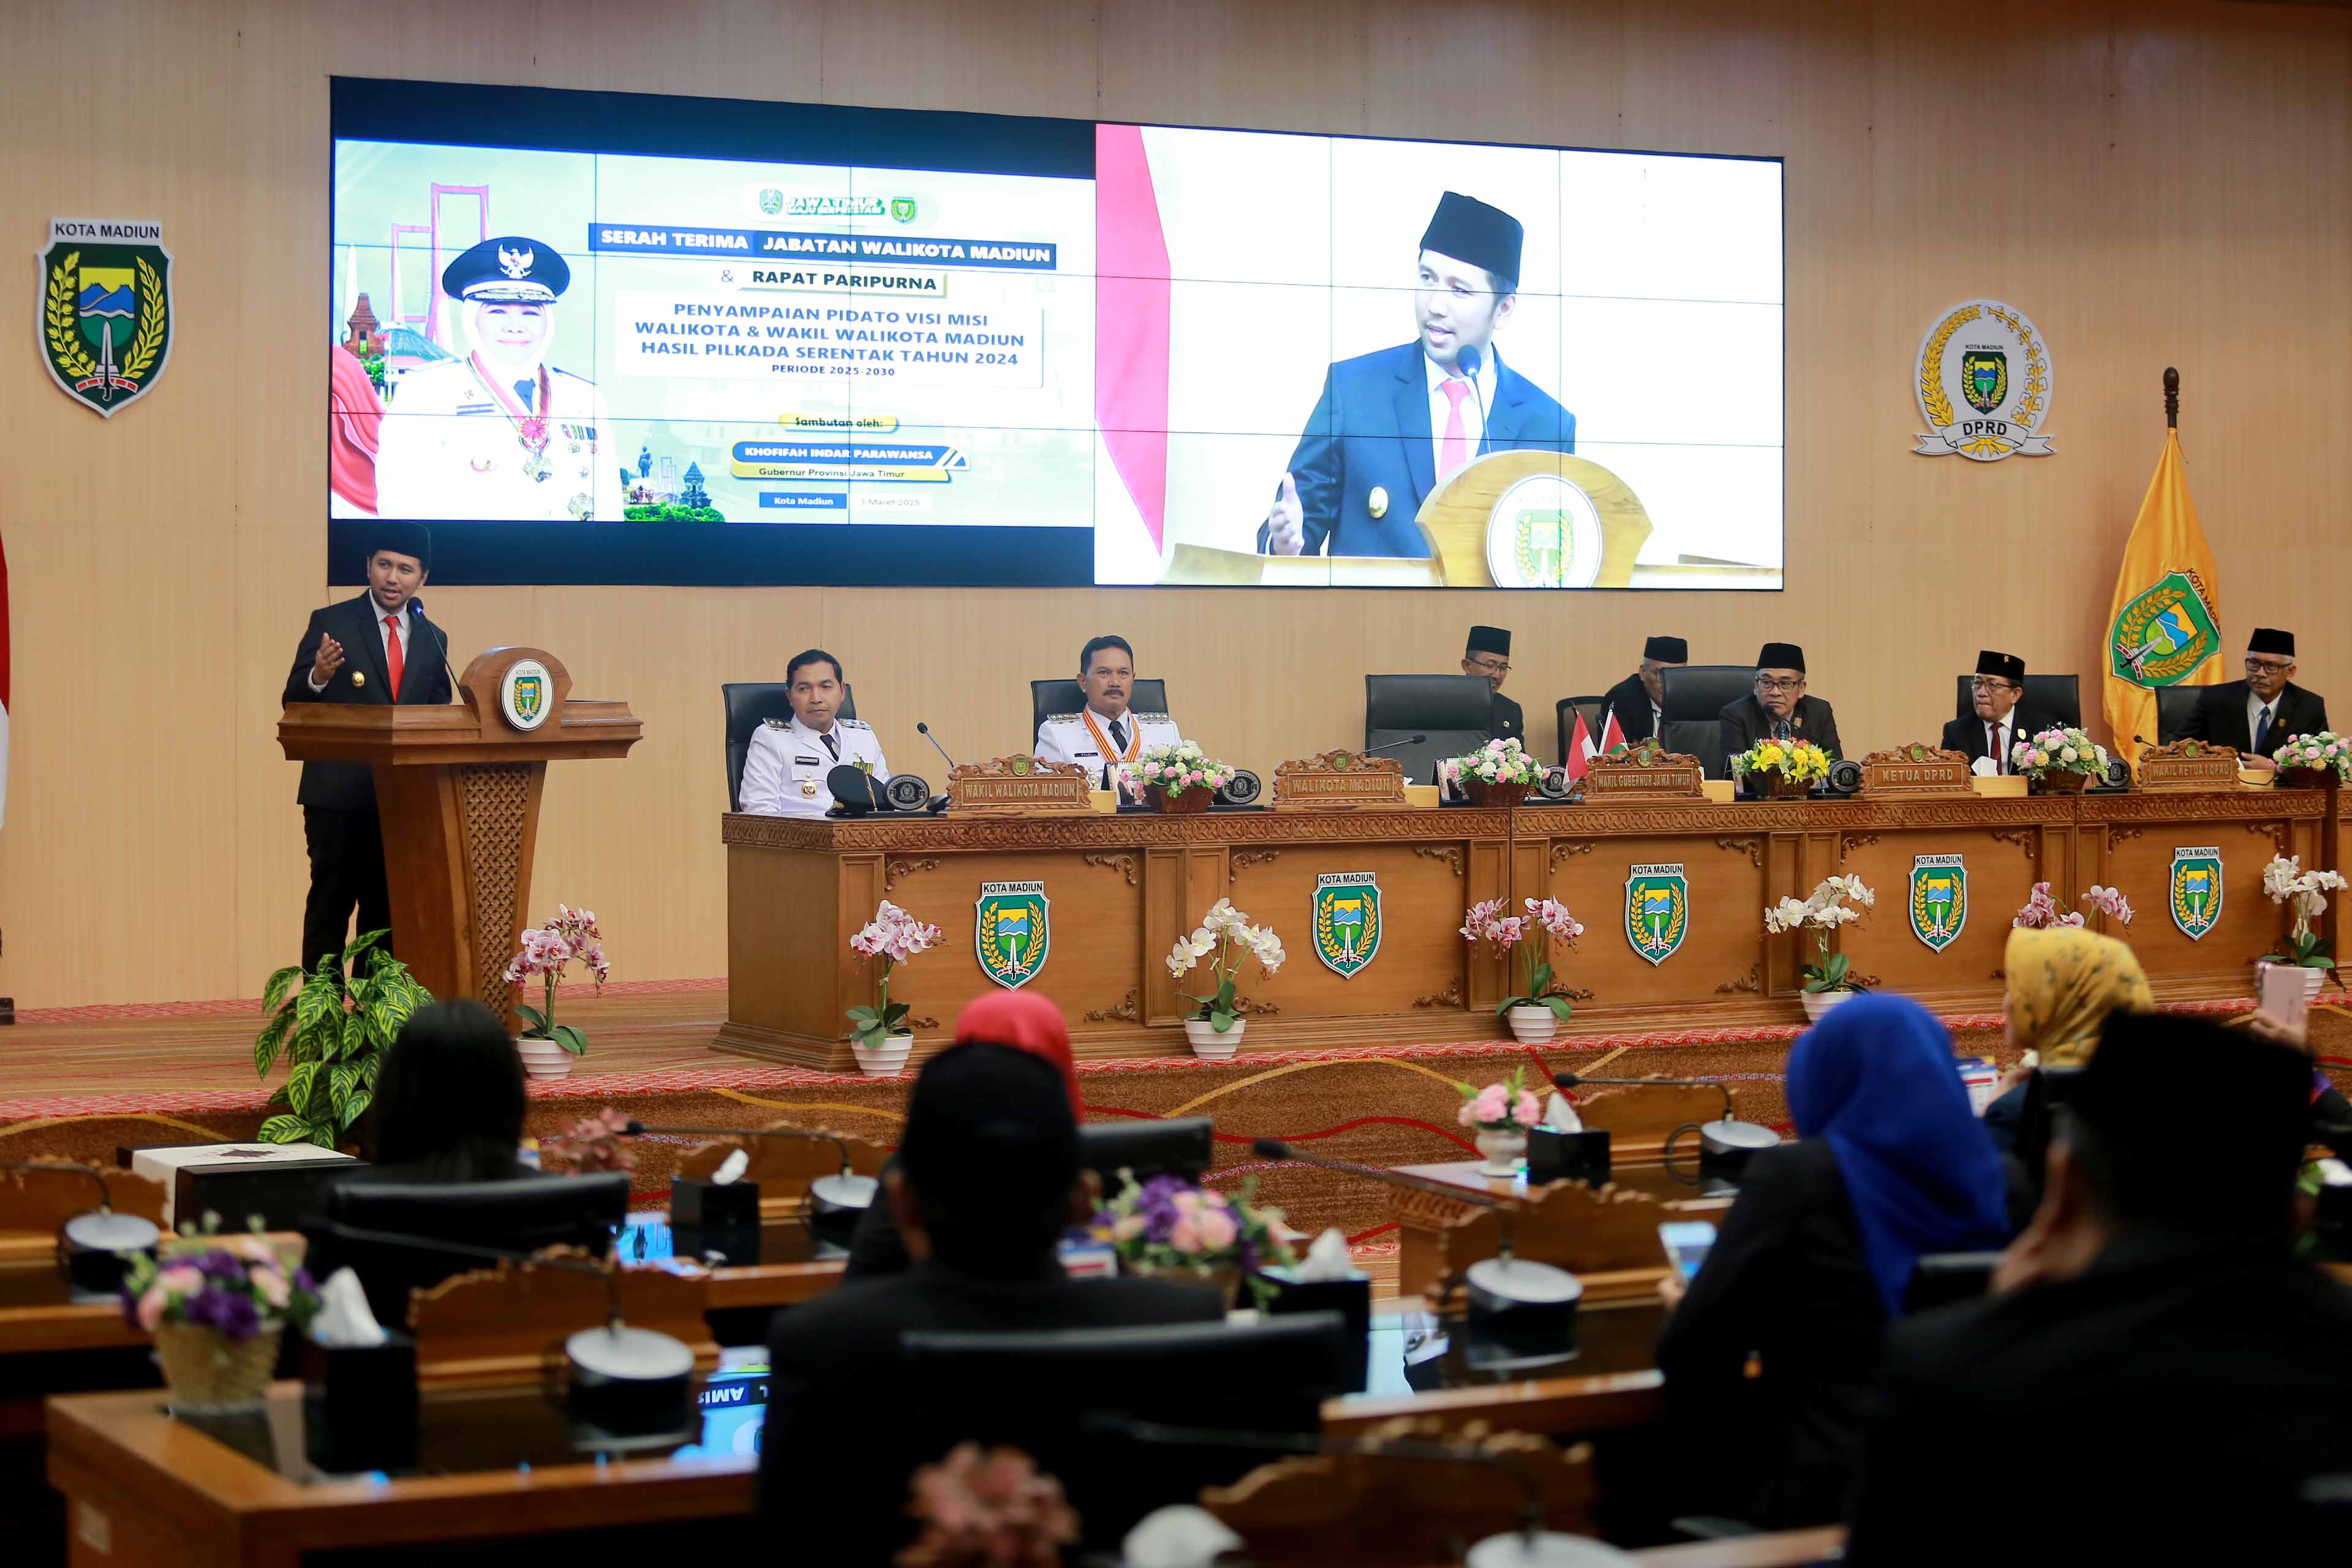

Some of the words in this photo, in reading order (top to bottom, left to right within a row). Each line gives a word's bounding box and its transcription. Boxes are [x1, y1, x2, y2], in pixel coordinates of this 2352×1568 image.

[55, 223, 96, 236] KOTA
[100, 225, 159, 238] MADIUN
[601, 230, 667, 246] SERAH
[671, 232, 749, 249] TERIMA
[763, 236, 857, 254] JABATAN
[861, 241, 966, 258] WALIKOTA
[970, 246, 1050, 262] MADIUN
[721, 270, 734, 282] &
[753, 271, 818, 285] RAPAT
[824, 273, 937, 290] PARIPURNA
[674, 303, 820, 320] PENYAMPAIAN
[827, 309, 900, 323] PIDATO
[906, 312, 941, 325] VISI
[948, 314, 987, 326] MISI
[635, 322, 740, 337] WALIKOTA
[747, 326, 760, 337] &
[766, 326, 829, 340] WAKIL
[835, 329, 938, 344] WALIKOTA
[945, 333, 1023, 347] MADIUN
[642, 342, 698, 355] HASIL
[706, 344, 789, 358] PILKADA
[796, 347, 894, 361] SERENTAK
[900, 350, 968, 363] TAHUN
[974, 353, 1018, 365] 2024
[772, 364, 826, 374] PERIODE
[830, 367, 895, 376] 2025-2030
[796, 417, 853, 428] Sambutan
[856, 419, 883, 428] oleh:
[1963, 421, 2007, 435] DPRD
[745, 447, 807, 458] KHOFIFAH
[810, 448, 850, 458] INDAR
[851, 450, 933, 459] PARAWANSA
[774, 497, 796, 505] Kota
[797, 497, 834, 506] Madiun
[2186, 568, 2206, 595] KOTA
[1882, 769, 1920, 782] KETUA
[1924, 769, 1953, 781] DPRD
[2152, 764, 2176, 776] WAKIL
[2179, 764, 2203, 775] KETUA
[2210, 764, 2230, 775] DPRD
[1292, 779, 1346, 793] WALIKOTA
[1349, 778, 1389, 792] MADIUN
[1597, 775, 1618, 788] WAKIL
[1619, 775, 1652, 787] GUBERNUR
[1653, 774, 1670, 786] JAWA
[1671, 774, 1691, 786] TIMUR
[965, 784, 993, 798] WAKIL
[995, 783, 1039, 797] WALIKOTA
[1041, 783, 1075, 797] MADIUN
[1632, 866, 1652, 875] KOTA
[1319, 875, 1341, 884] KOTA
[1343, 873, 1374, 883] MADIUN
[984, 884, 1007, 892] KOTA
[1009, 883, 1042, 892] MADIUN
